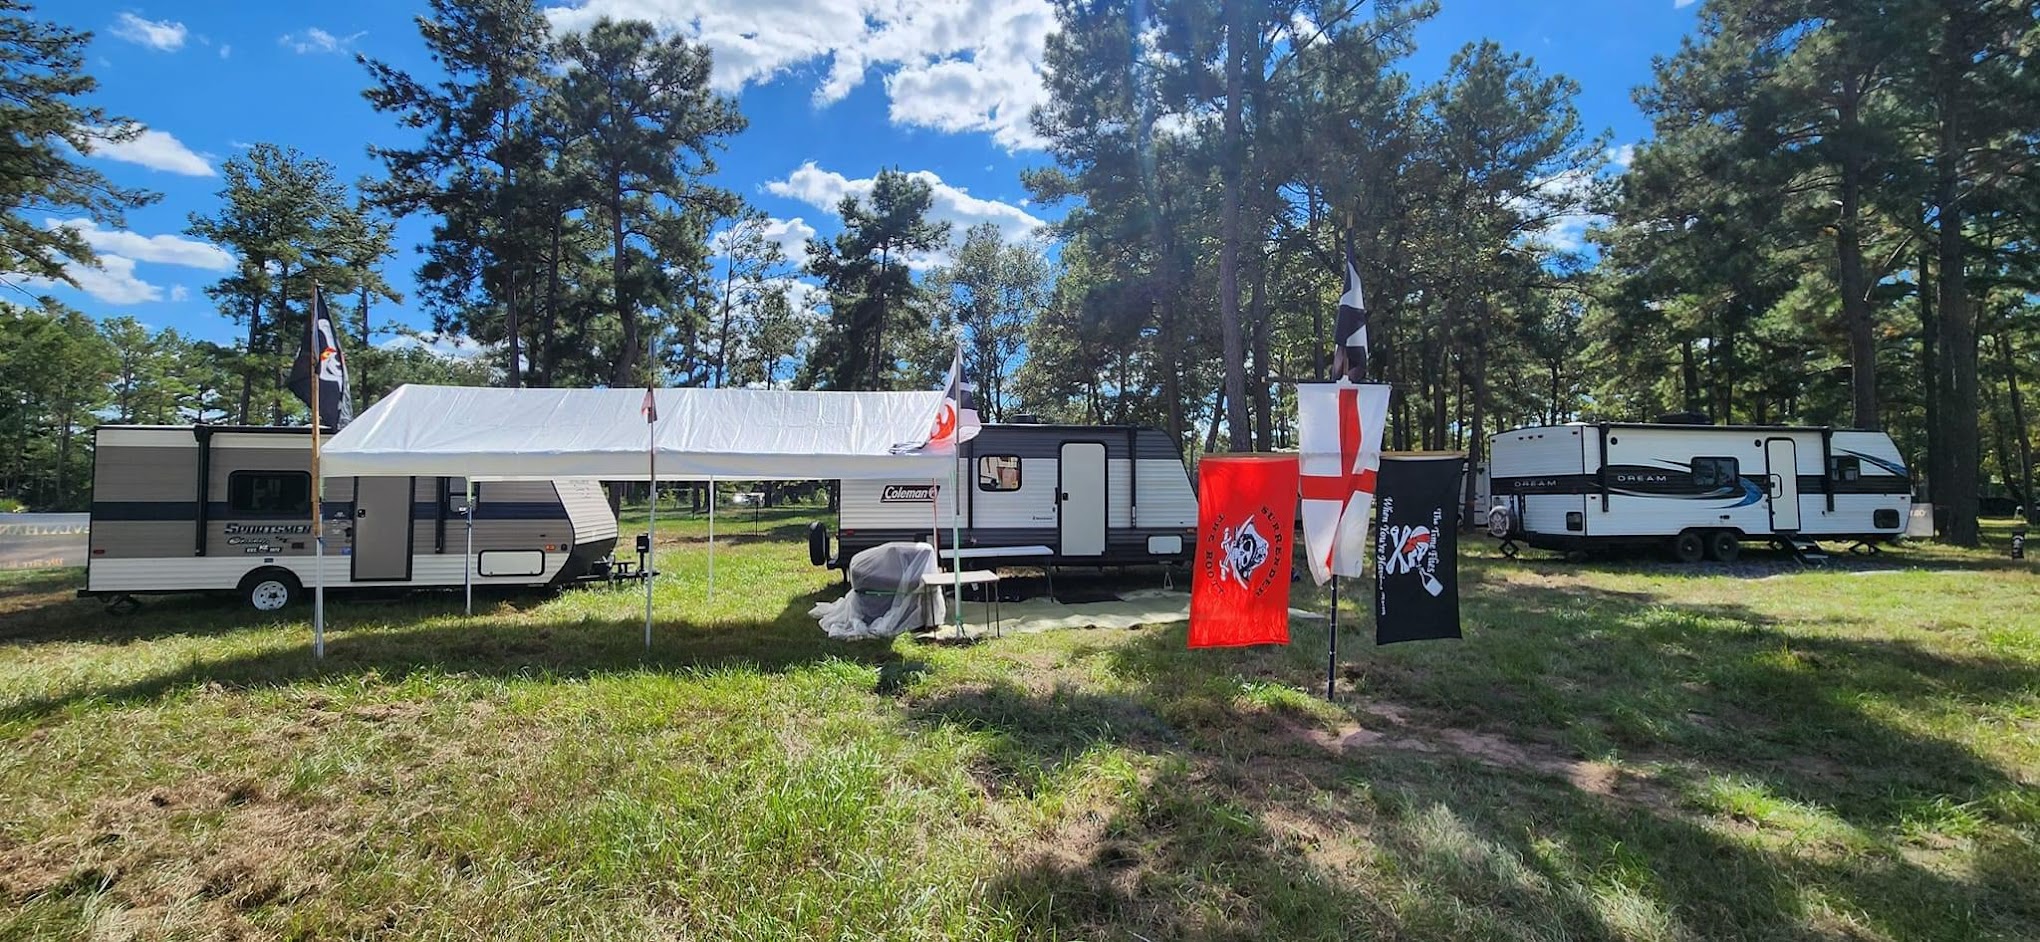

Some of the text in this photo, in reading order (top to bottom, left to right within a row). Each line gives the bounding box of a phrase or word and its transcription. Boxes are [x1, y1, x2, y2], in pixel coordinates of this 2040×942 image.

[1617, 474, 1667, 482] DREAM
[885, 486, 928, 499] Coleman
[1381, 497, 1393, 523] When
[1256, 506, 1283, 597] SURRENDER
